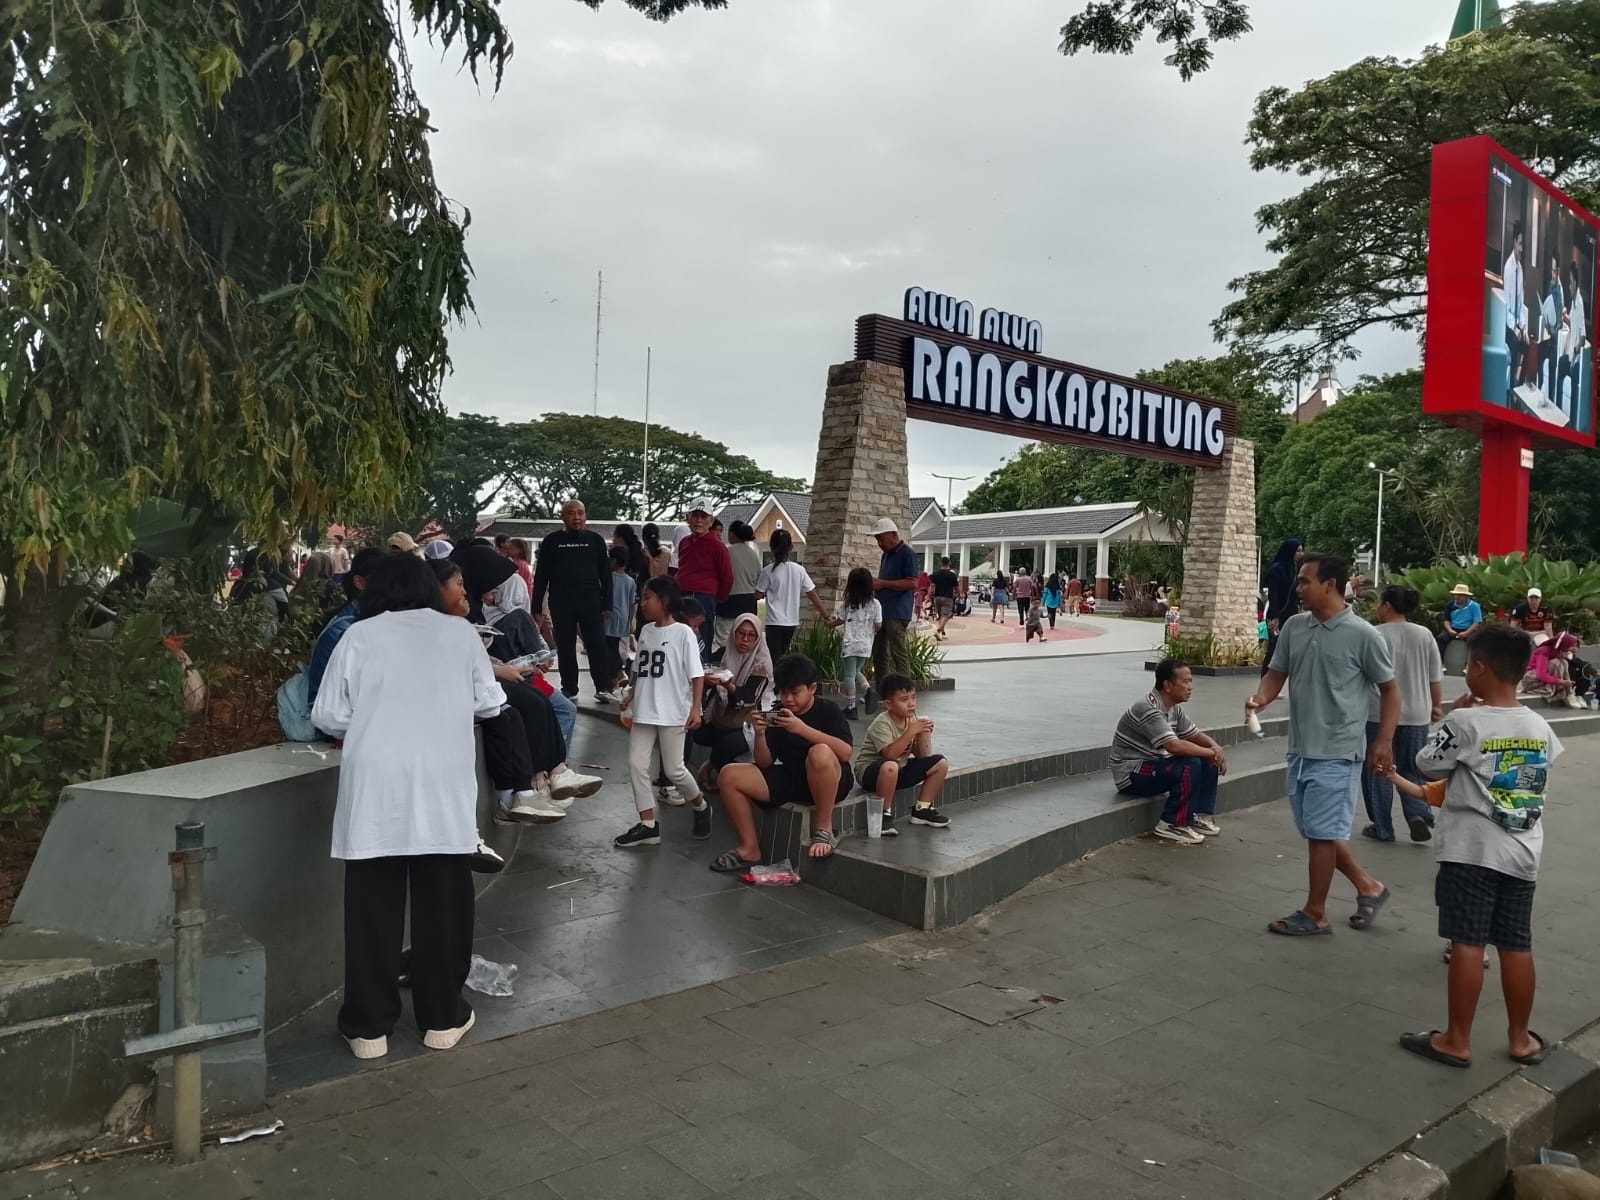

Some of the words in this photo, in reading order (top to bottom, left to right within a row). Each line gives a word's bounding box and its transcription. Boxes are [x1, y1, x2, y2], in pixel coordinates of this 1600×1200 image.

[905, 286, 974, 337] ALUN
[981, 307, 1042, 353] ALUN
[912, 336, 1224, 456] RANGKASBITUNG
[638, 650, 666, 678] 28
